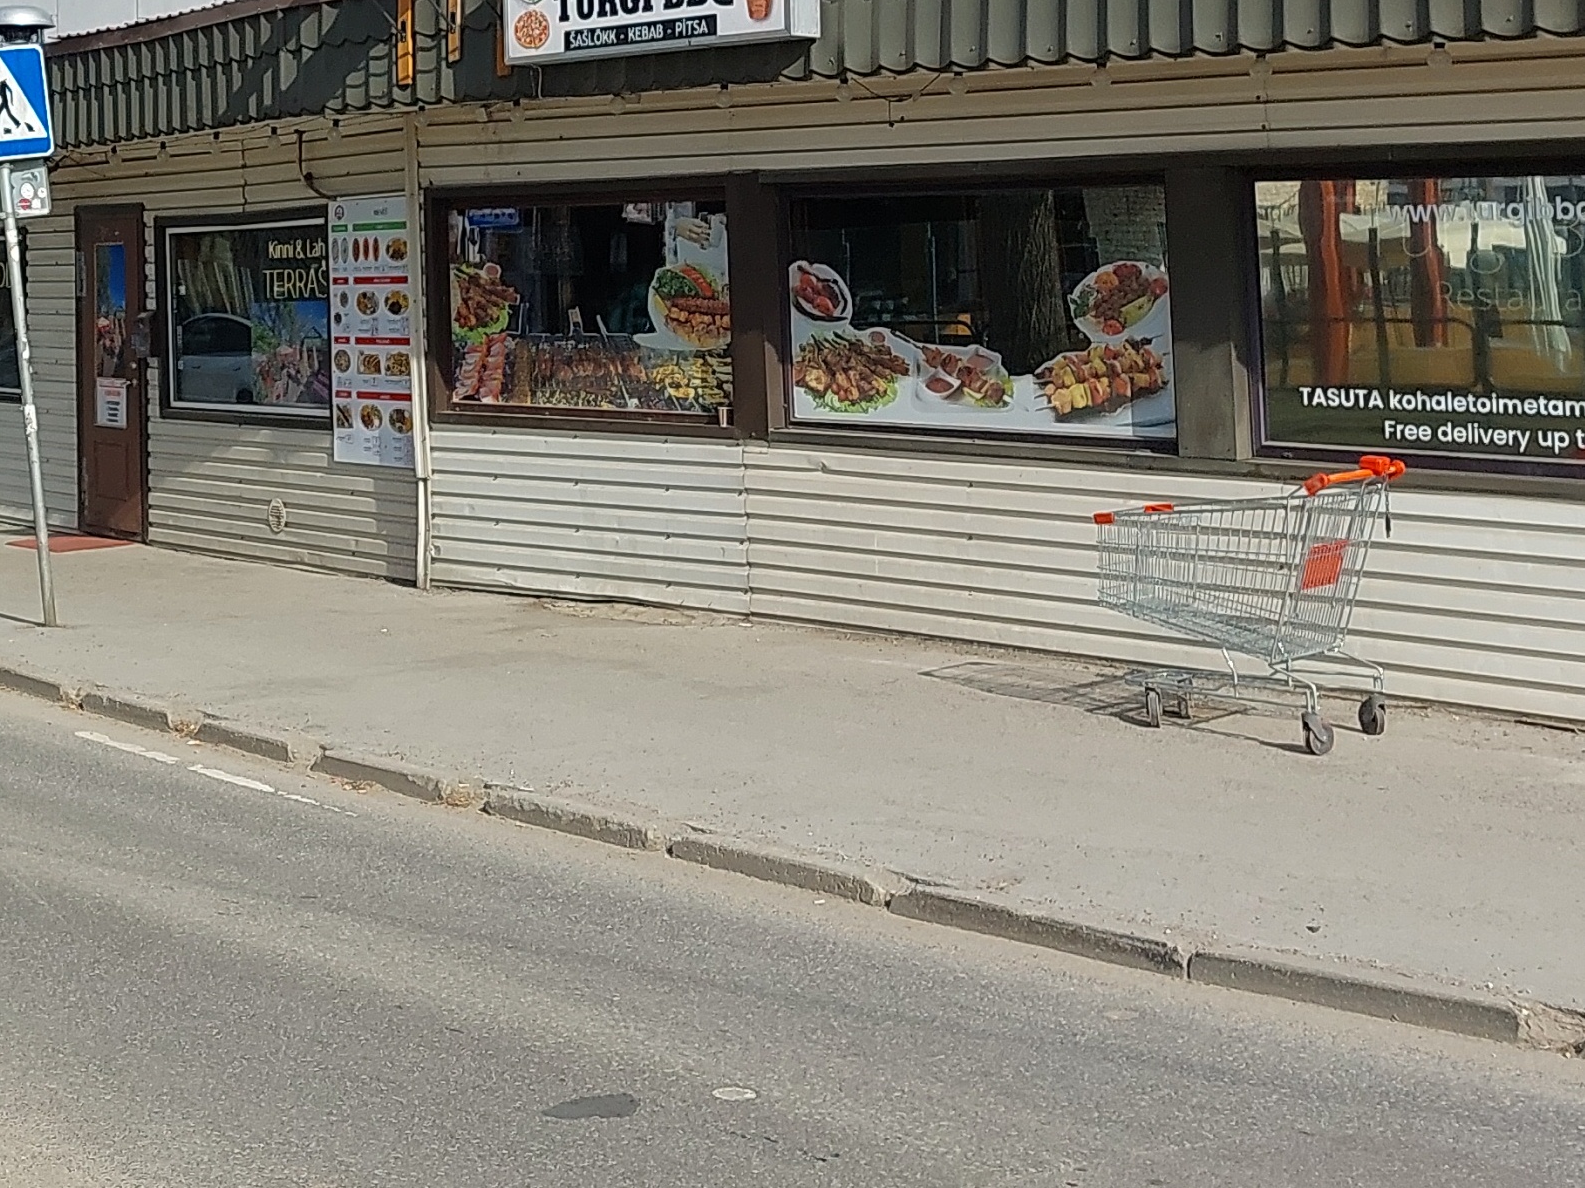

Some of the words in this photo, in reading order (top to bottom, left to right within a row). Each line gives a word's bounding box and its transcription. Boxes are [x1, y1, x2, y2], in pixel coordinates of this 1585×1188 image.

[627, 23, 664, 43] KEBAB
[268, 240, 294, 259] Kinni
[295, 239, 305, 259] &
[1300, 387, 1384, 410] TASUTA
[1384, 420, 1432, 442] Free
[1437, 422, 1531, 454] delivery
[1537, 430, 1570, 455] up
